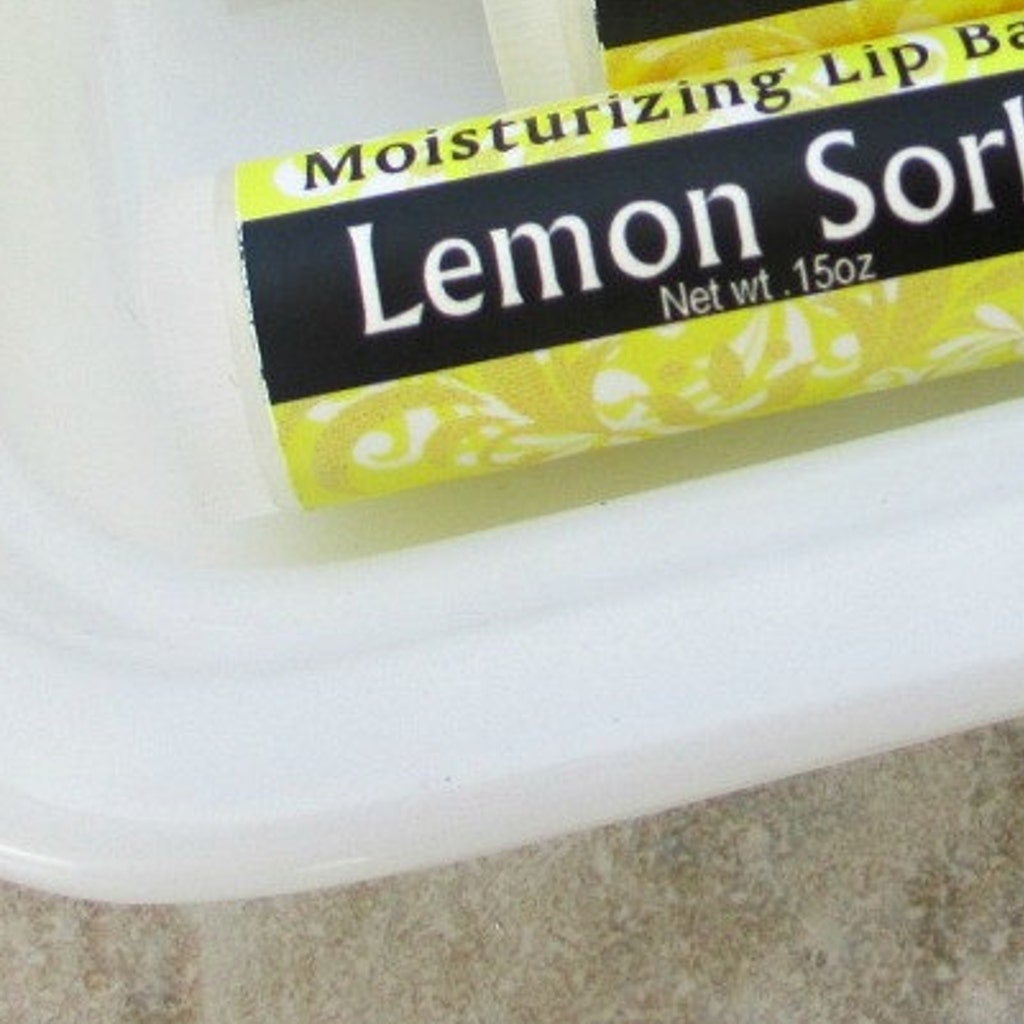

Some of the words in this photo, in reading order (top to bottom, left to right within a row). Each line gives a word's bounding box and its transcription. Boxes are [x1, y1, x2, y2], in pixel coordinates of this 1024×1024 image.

[303, 67, 791, 190] Moisturizing
[822, 41, 930, 88] Lip
[346, 182, 763, 336] Lemon
[660, 282, 723, 320] Net
[730, 275, 772, 306] wt
[781, 251, 876, 296] .15oz
